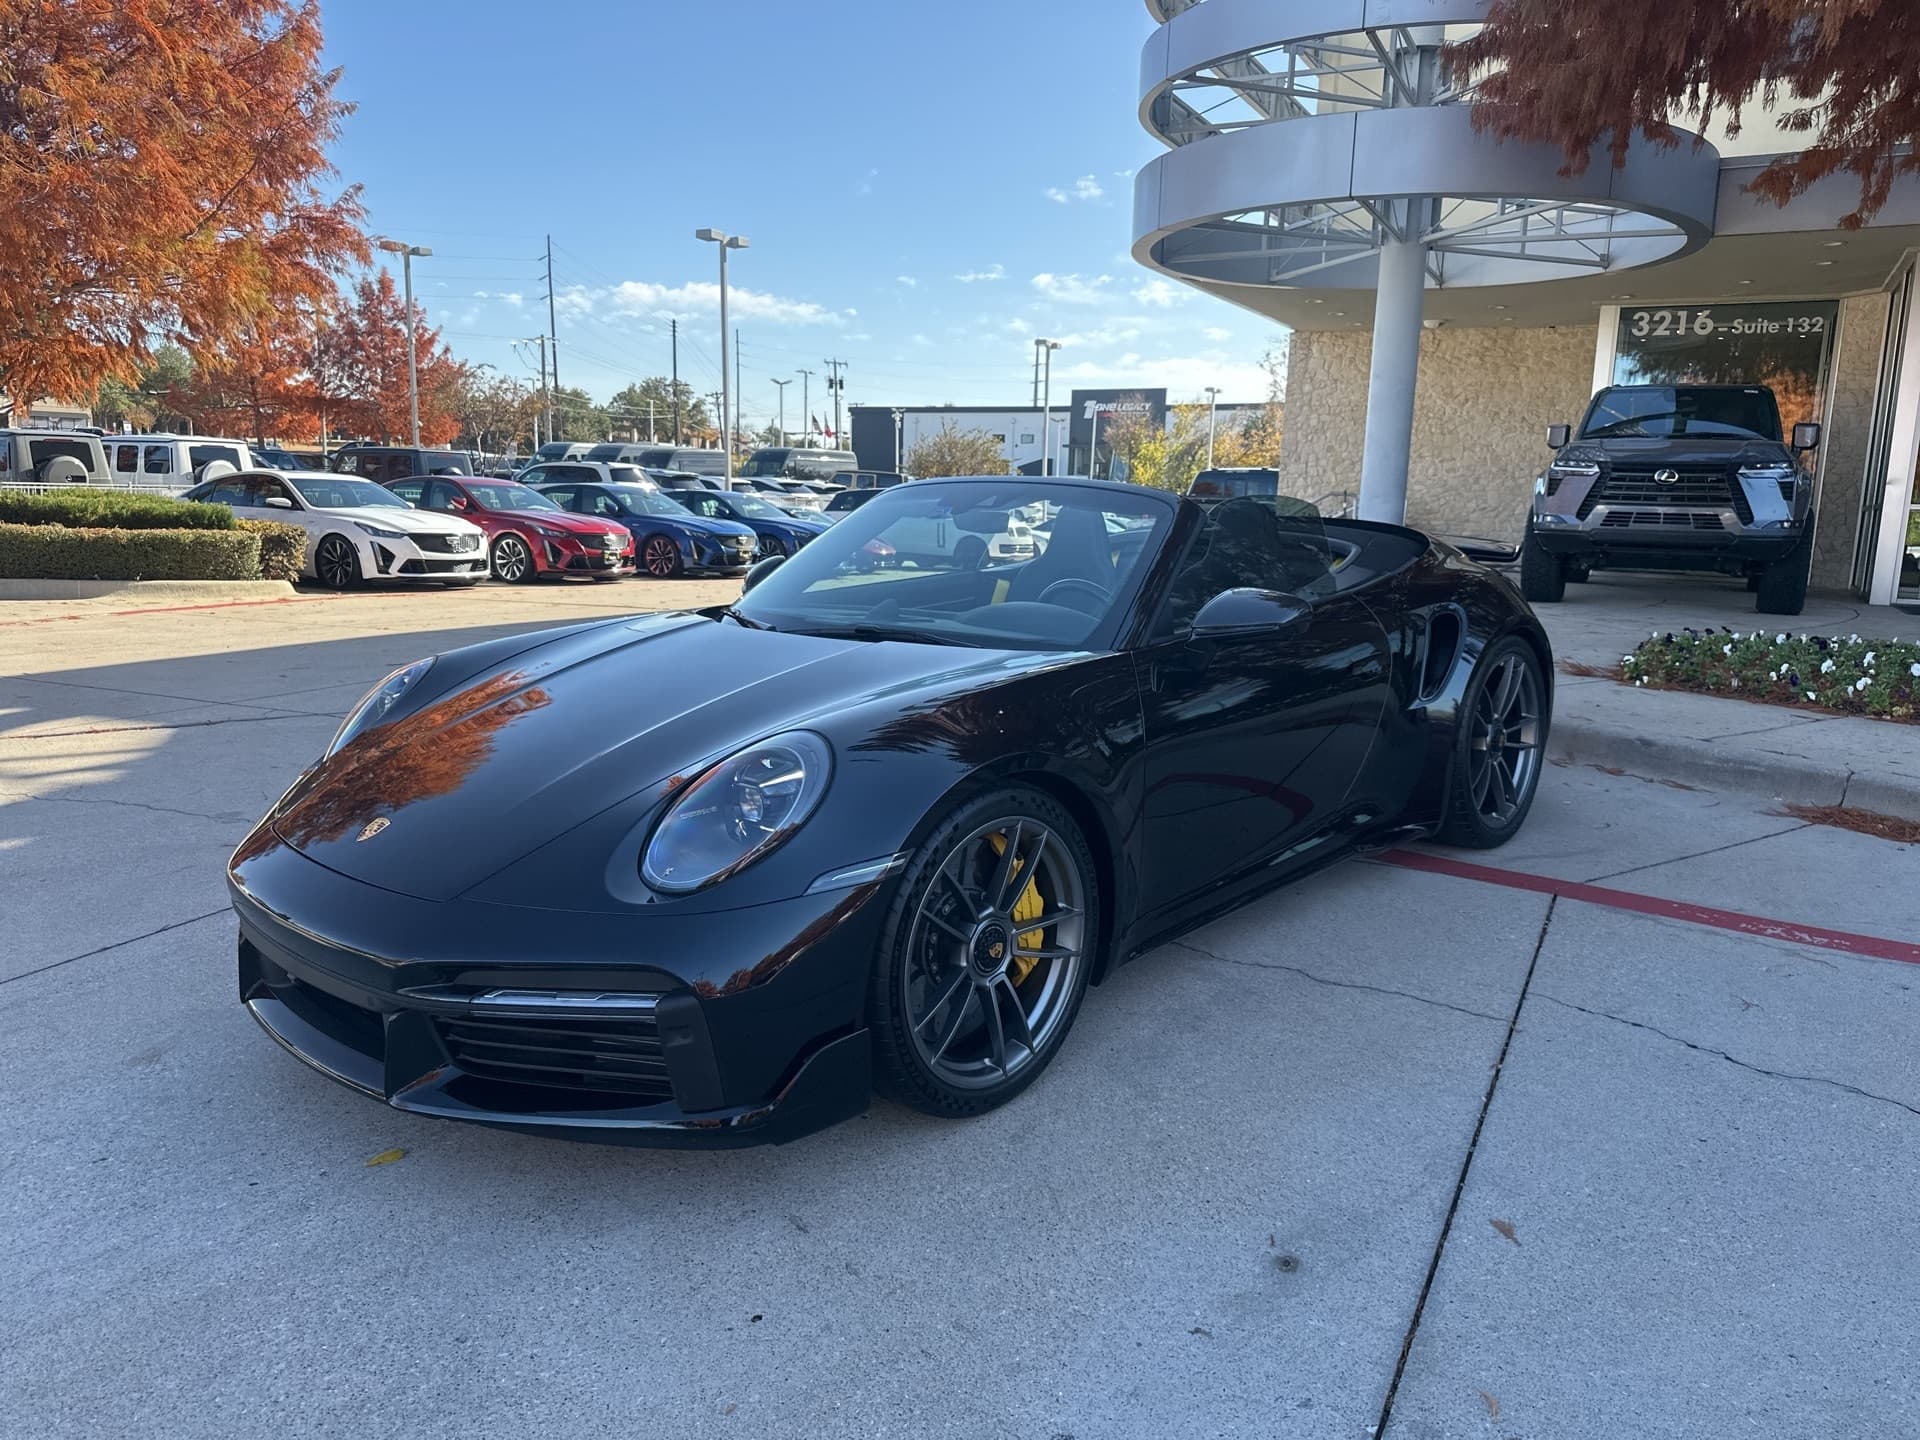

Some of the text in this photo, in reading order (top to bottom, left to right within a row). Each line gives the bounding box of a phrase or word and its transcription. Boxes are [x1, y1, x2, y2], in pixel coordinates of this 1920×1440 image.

[1631, 310, 1714, 337] 3216
[1732, 317, 1780, 334] Suite
[1787, 316, 1824, 333] 132
